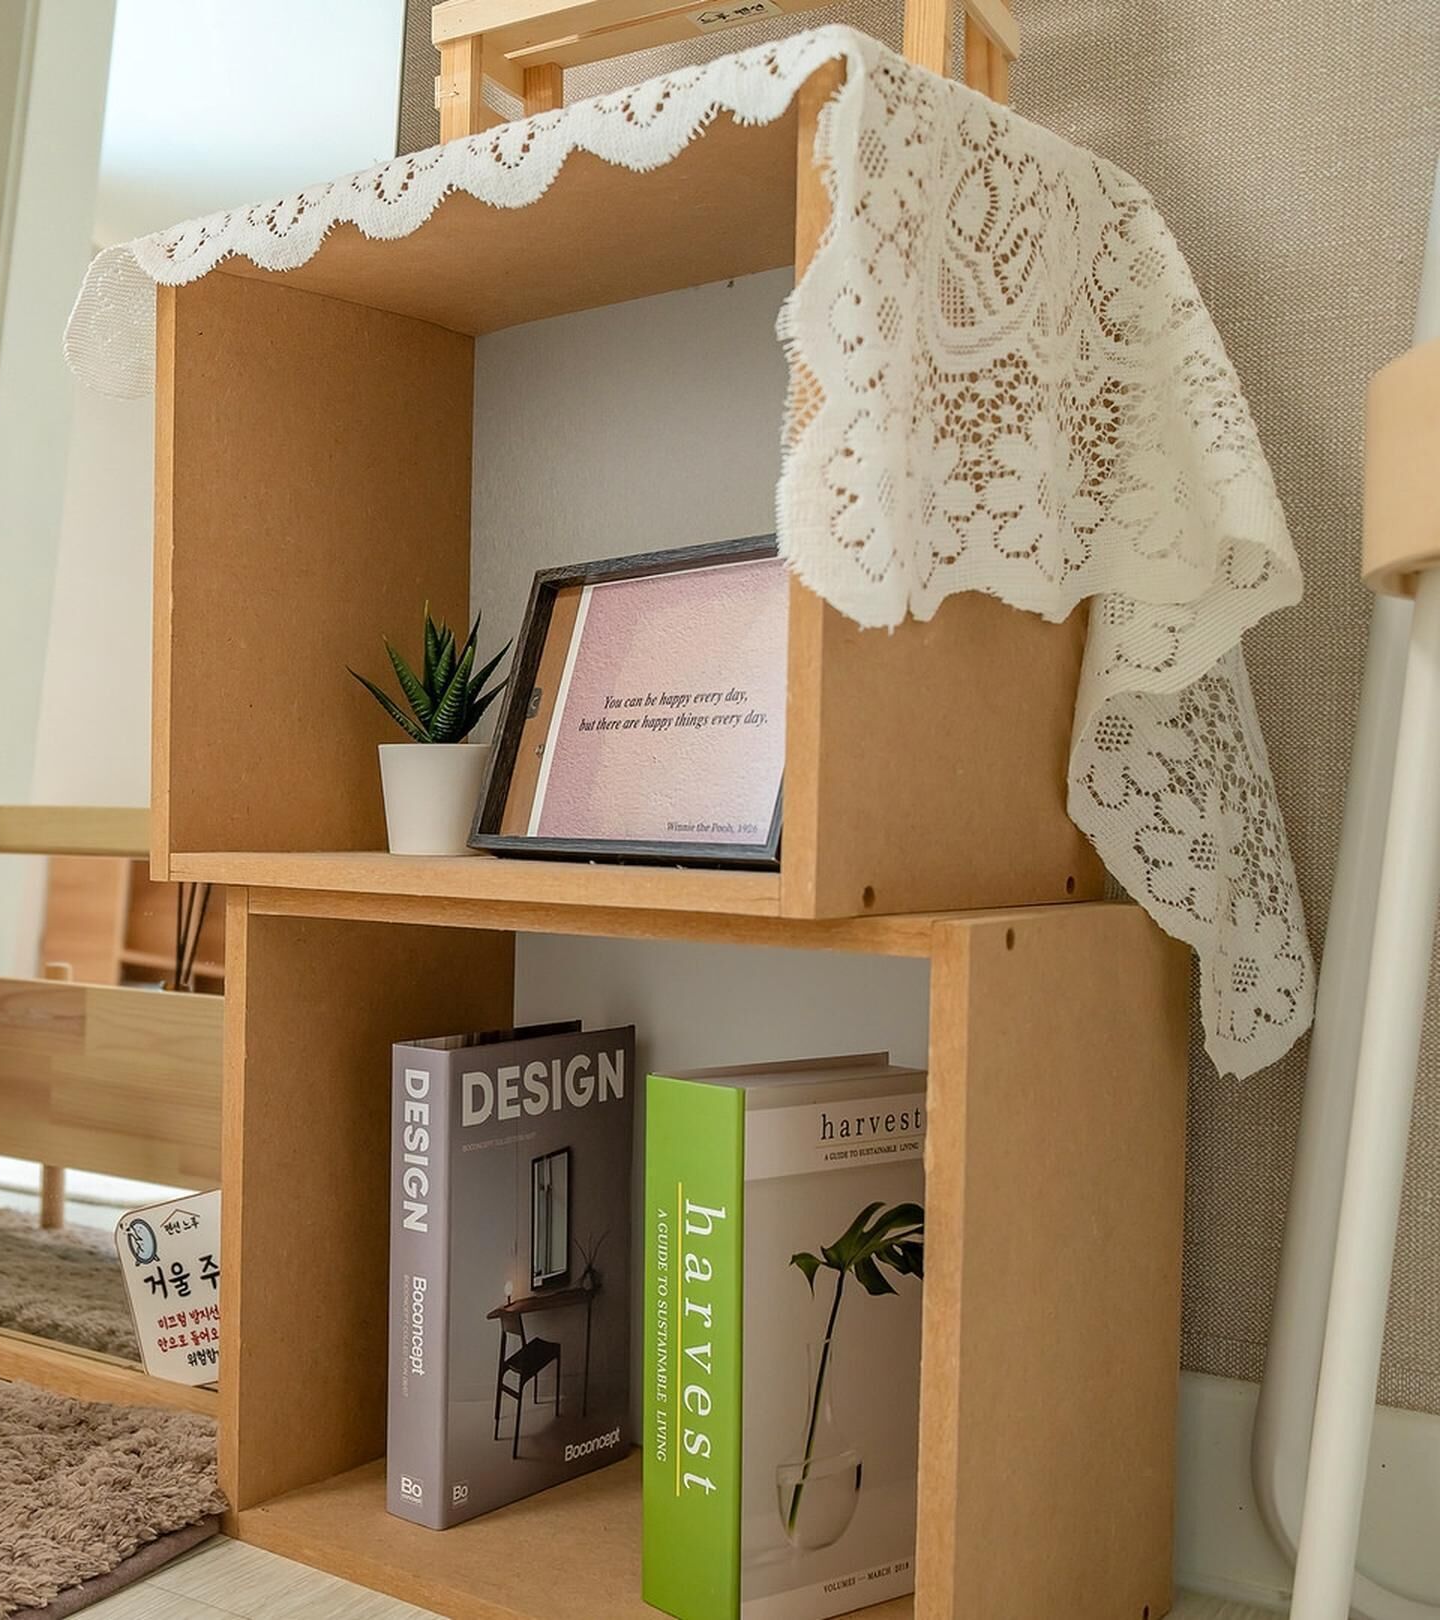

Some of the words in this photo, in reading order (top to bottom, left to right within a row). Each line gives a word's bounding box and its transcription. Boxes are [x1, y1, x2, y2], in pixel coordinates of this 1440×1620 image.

[603, 696, 623, 709] You
[624, 697, 642, 708] can
[645, 693, 657, 706] be
[659, 692, 692, 708] happy
[694, 693, 723, 705] every
[578, 719, 596, 731] but
[596, 717, 621, 731] there
[622, 719, 638, 730] are
[641, 716, 674, 731] happy
[675, 713, 708, 729] things
[711, 714, 741, 728] every
[744, 710, 768, 727] day.
[462, 1049, 625, 1127] DESIGN
[821, 1108, 921, 1140] harvest
[403, 1068, 430, 1233] DESIGN
[659, 1208, 668, 1218] A
[657, 1222, 668, 1271] GUIDE
[144, 1262, 191, 1299] 거울
[199, 1255, 220, 1289] 주
[657, 1275, 668, 1294] TO
[157, 1311, 187, 1330] 미끄럼
[189, 1304, 220, 1324] 방지선
[409, 1276, 427, 1376] Boconcept
[157, 1334, 188, 1352] 안으로
[187, 1348, 219, 1366] 위험합
[656, 1294, 668, 1402] SUSTAINABLE
[683, 1199, 726, 1495] harvest
[564, 1427, 620, 1461] Boconcept
[656, 1409, 667, 1462] LIVING
[401, 1476, 423, 1498] Bo
[453, 1485, 468, 1501] Bo
